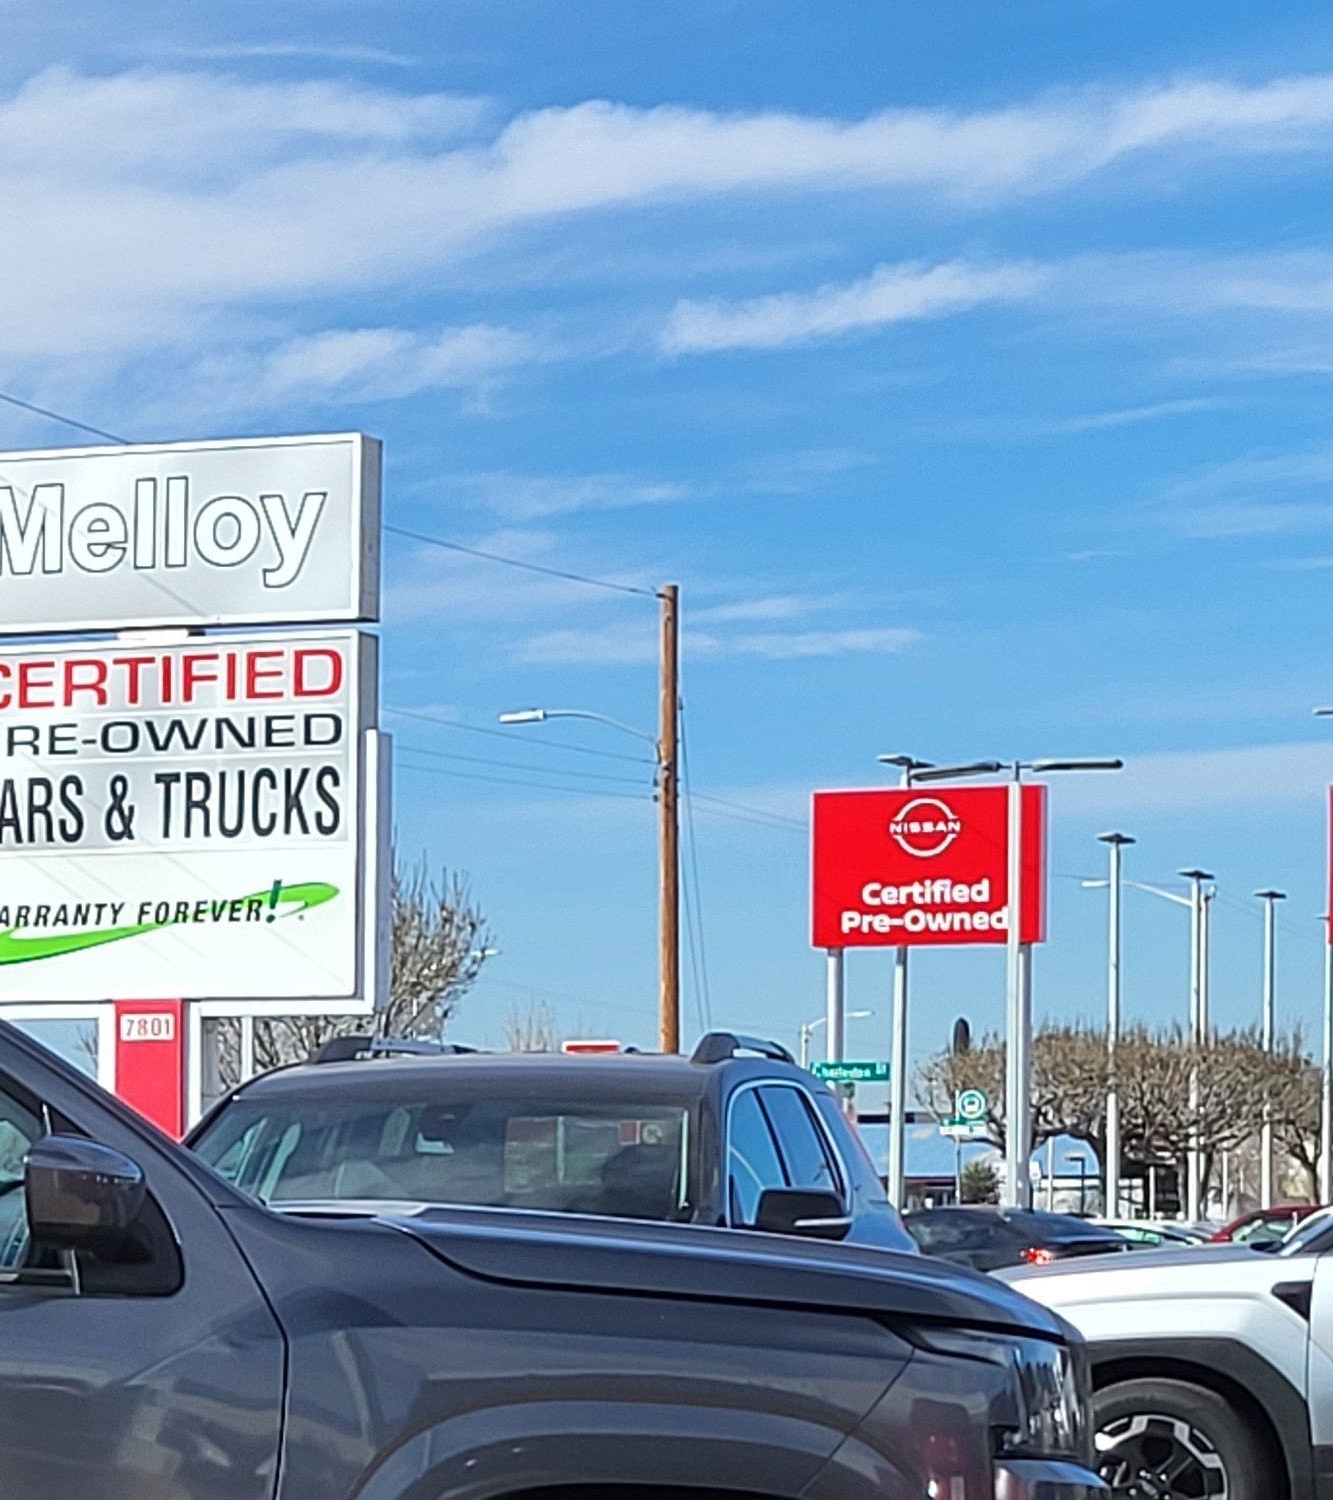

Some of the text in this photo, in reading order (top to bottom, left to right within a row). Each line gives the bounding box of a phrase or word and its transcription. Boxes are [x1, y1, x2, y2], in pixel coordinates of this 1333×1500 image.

[105, 775, 134, 841] &
[154, 766, 341, 839] TRUCKS
[889, 820, 961, 834] NISSAN
[136, 879, 283, 925] FOREVER!
[862, 878, 990, 906] Certified
[841, 905, 1010, 934] Pre-Owned
[126, 1017, 170, 1036] 7801
